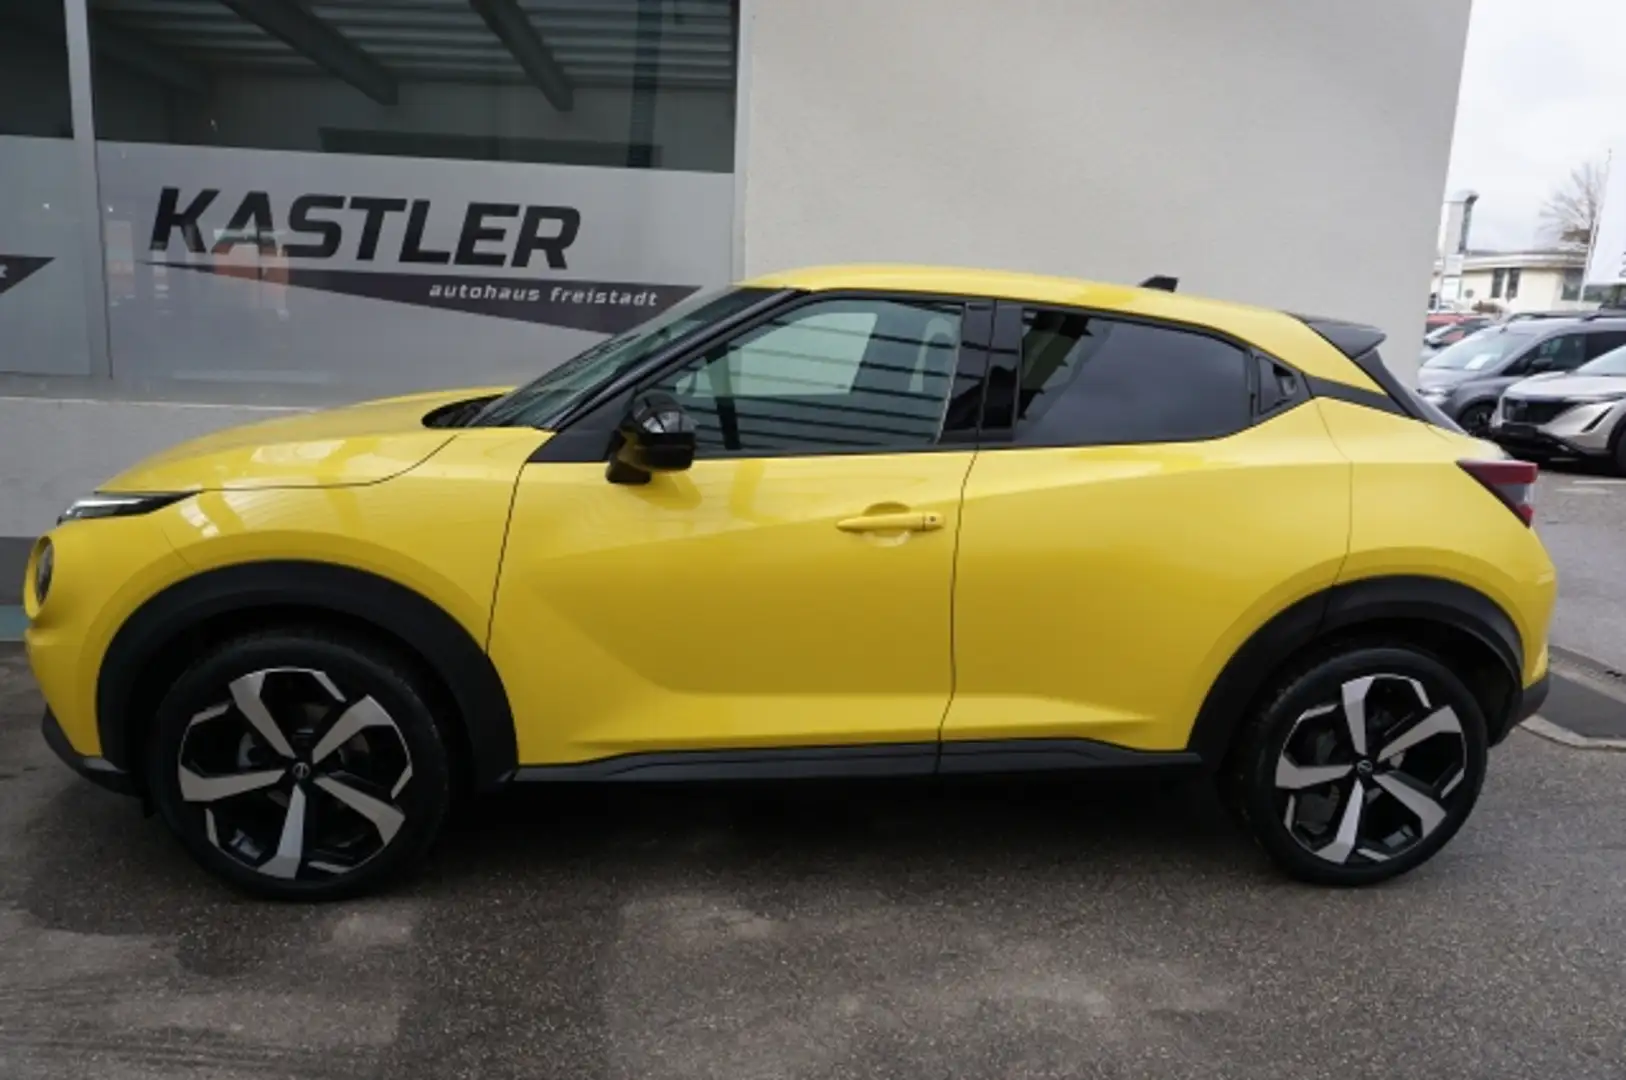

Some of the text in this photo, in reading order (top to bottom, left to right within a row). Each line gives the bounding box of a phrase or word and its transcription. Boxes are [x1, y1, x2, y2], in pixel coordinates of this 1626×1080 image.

[149, 186, 581, 269] KASTLER
[429, 284, 658, 306] autohaus freistadt
